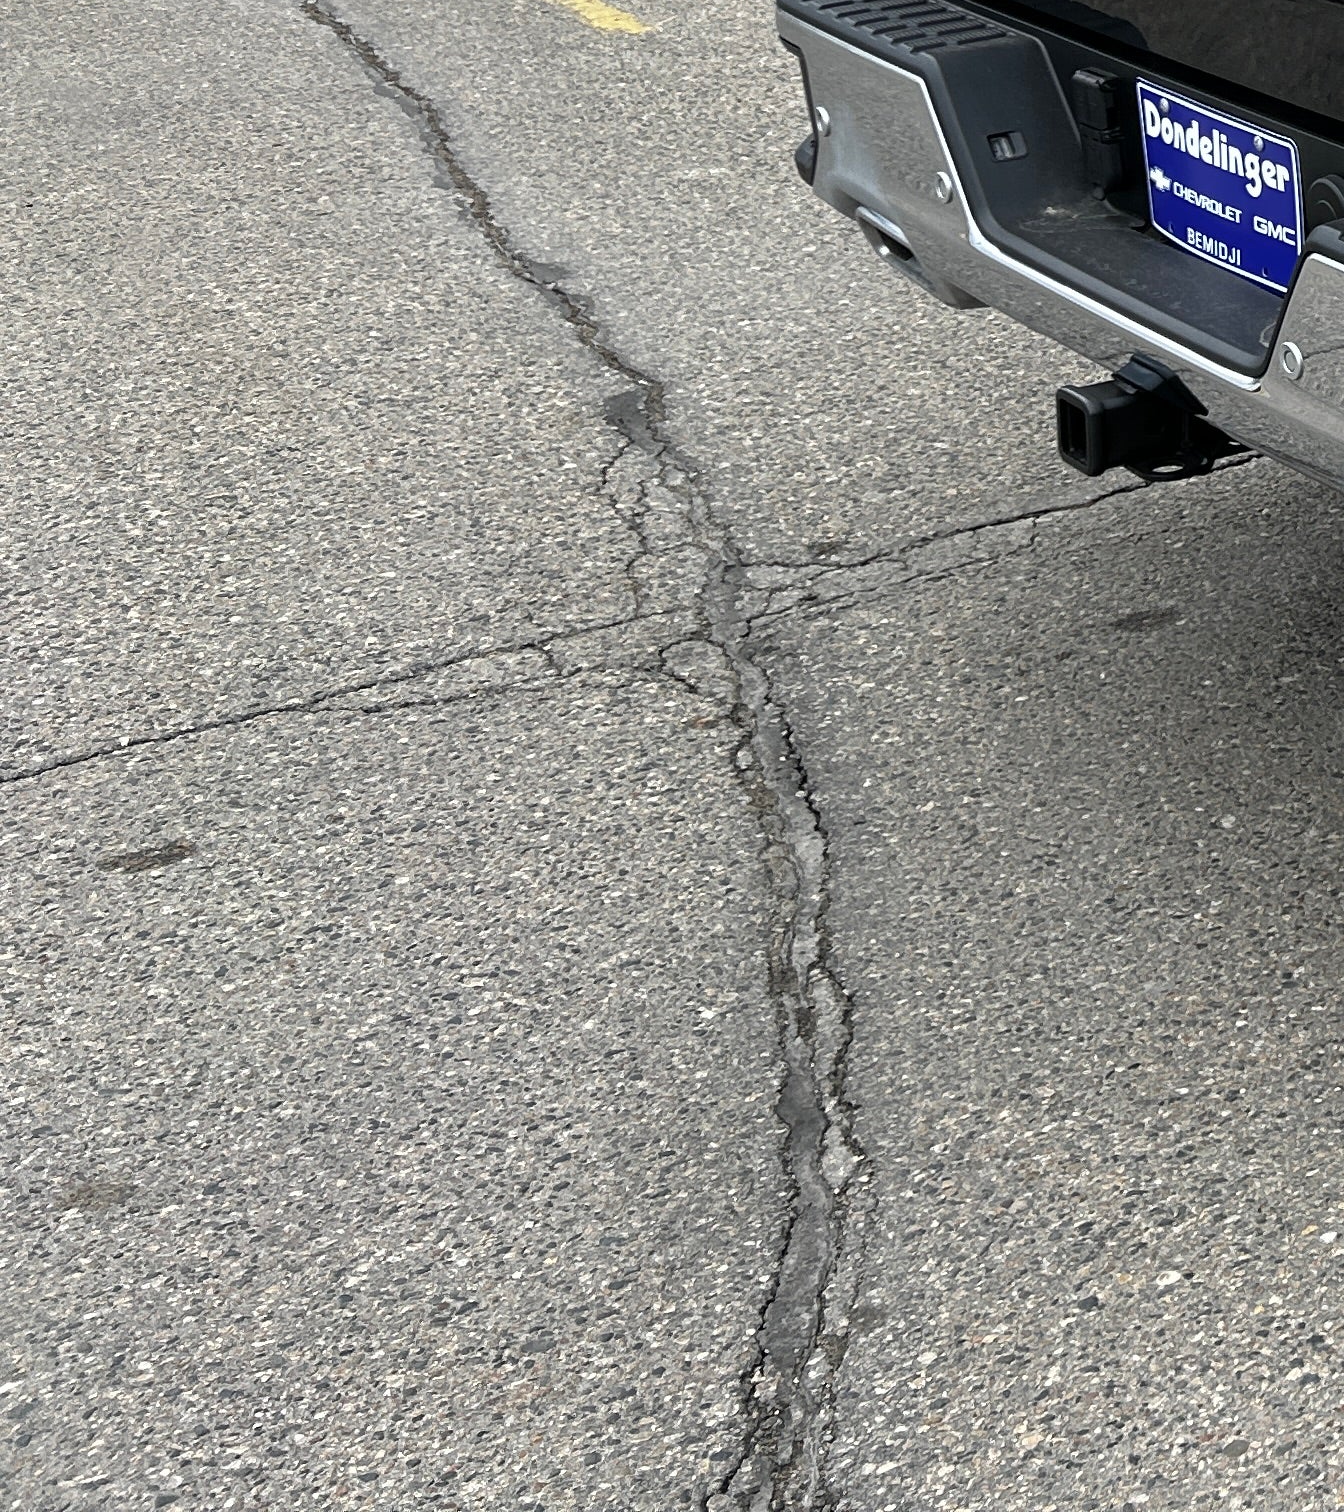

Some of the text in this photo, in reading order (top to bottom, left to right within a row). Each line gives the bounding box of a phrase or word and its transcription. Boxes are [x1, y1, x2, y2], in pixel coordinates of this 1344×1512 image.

[1143, 98, 1290, 198] Dondelinger
[1173, 181, 1243, 224] CHEVROLET
[1186, 227, 1241, 266] BEMIDJI
[1253, 215, 1297, 246] GMC
